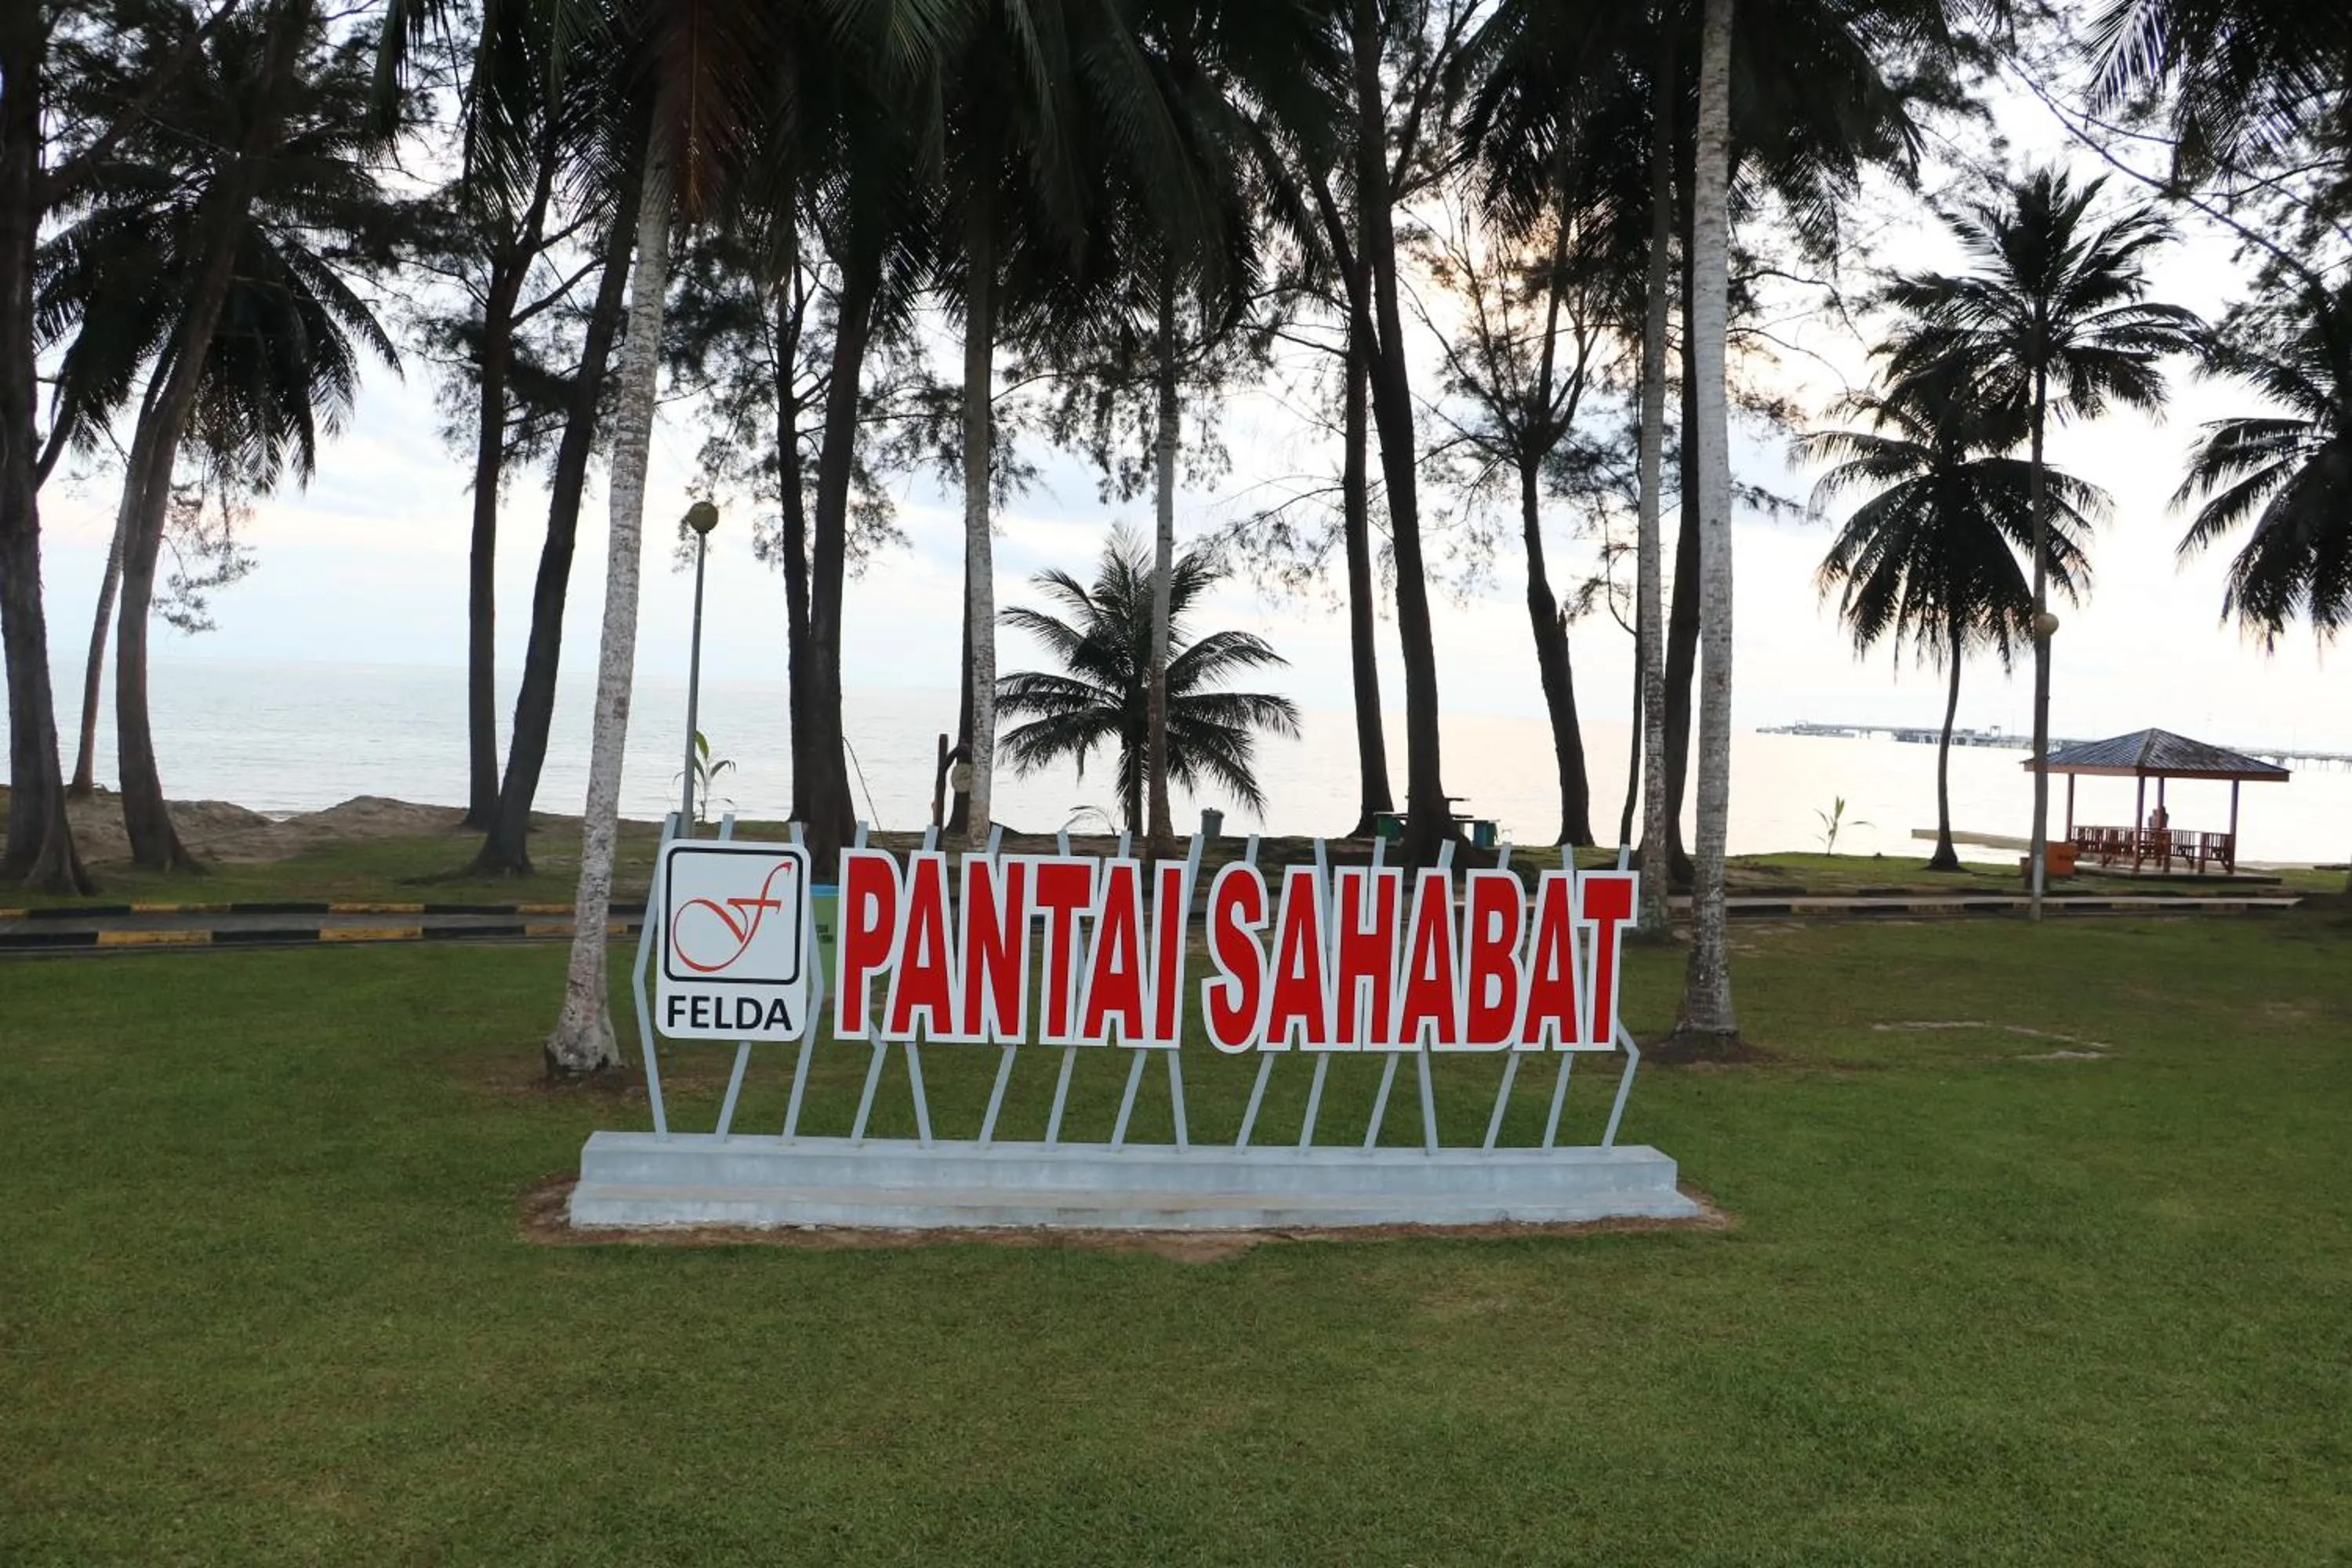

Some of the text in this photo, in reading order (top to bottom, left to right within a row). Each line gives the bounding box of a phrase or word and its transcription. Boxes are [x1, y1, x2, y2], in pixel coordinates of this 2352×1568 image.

[840, 855, 1633, 1047] PANTAI SAHABAT
[666, 994, 793, 1032] FELDA
